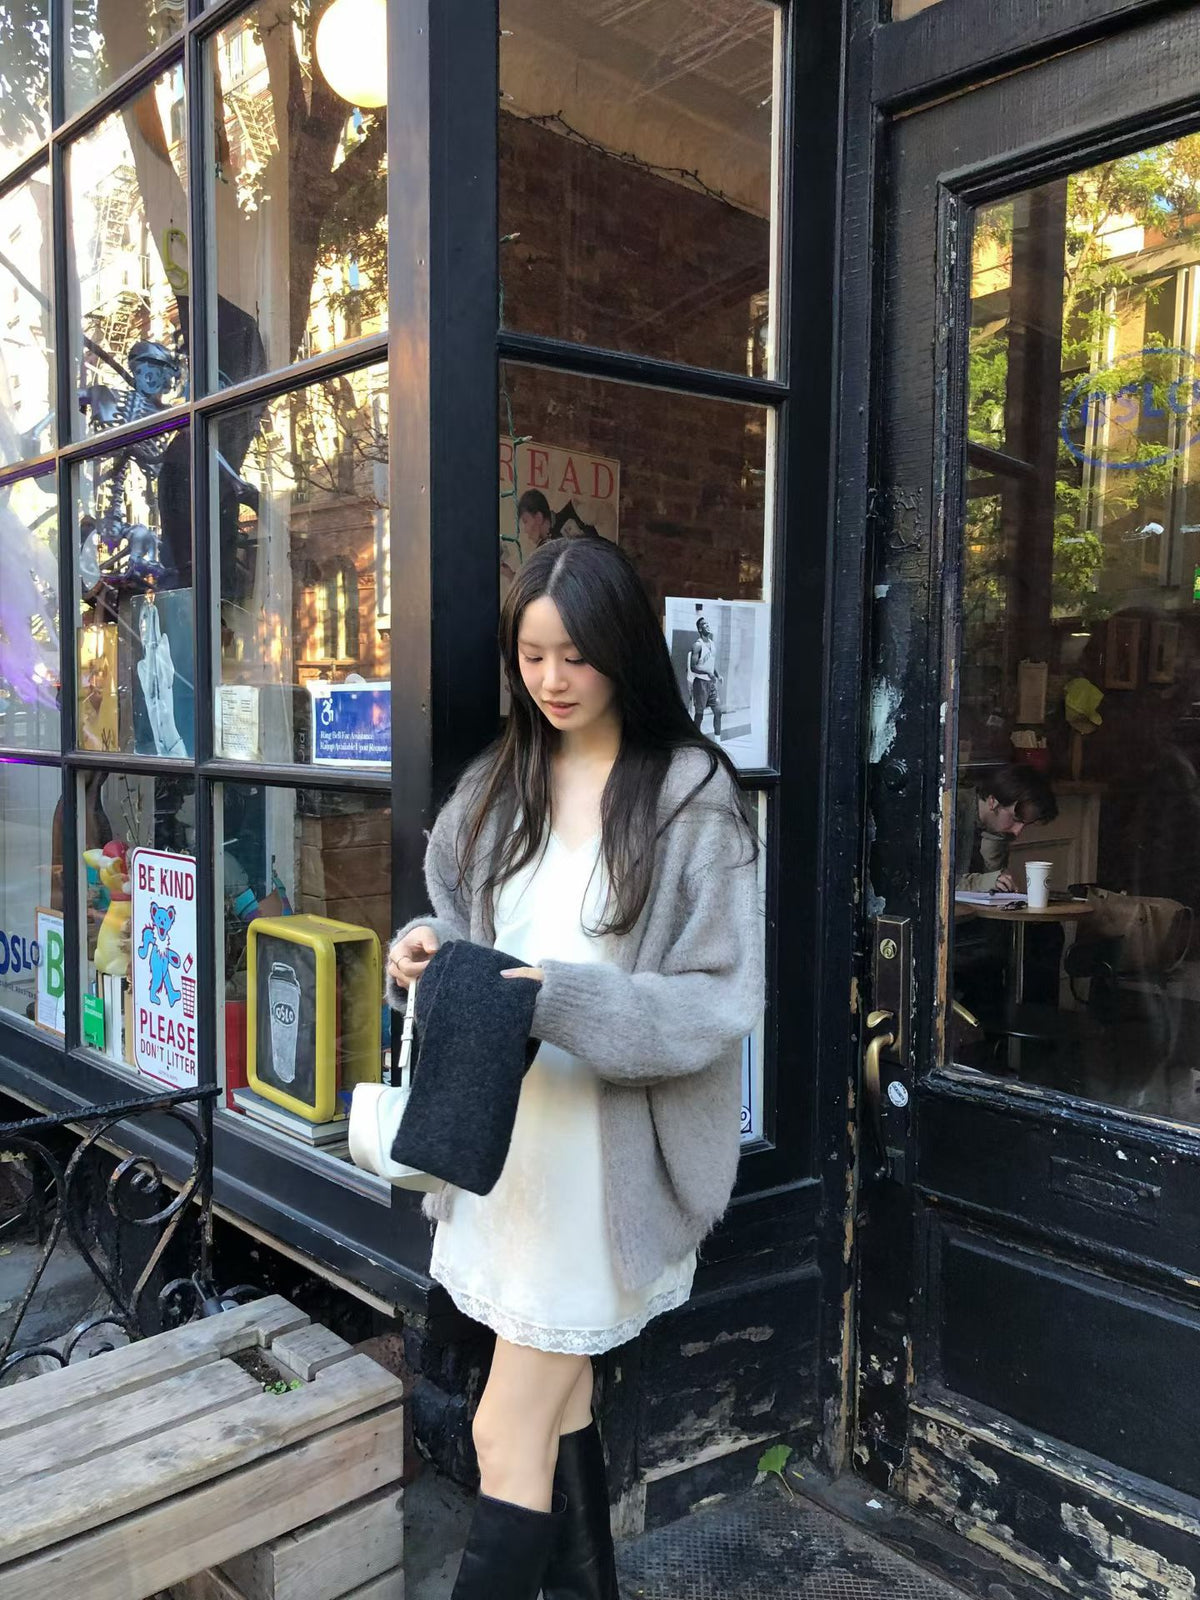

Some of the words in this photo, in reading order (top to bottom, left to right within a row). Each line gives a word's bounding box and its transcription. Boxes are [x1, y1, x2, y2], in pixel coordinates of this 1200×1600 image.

[500, 443, 614, 499] READ
[138, 863, 156, 893] BE
[160, 867, 195, 901] KIND
[0, 930, 40, 975] OSLO
[47, 929, 65, 998] B
[140, 1008, 196, 1055] PLEASE
[275, 1005, 294, 1022] OSLO
[140, 1038, 164, 1062] DON'T
[167, 1049, 196, 1076] LITTER
